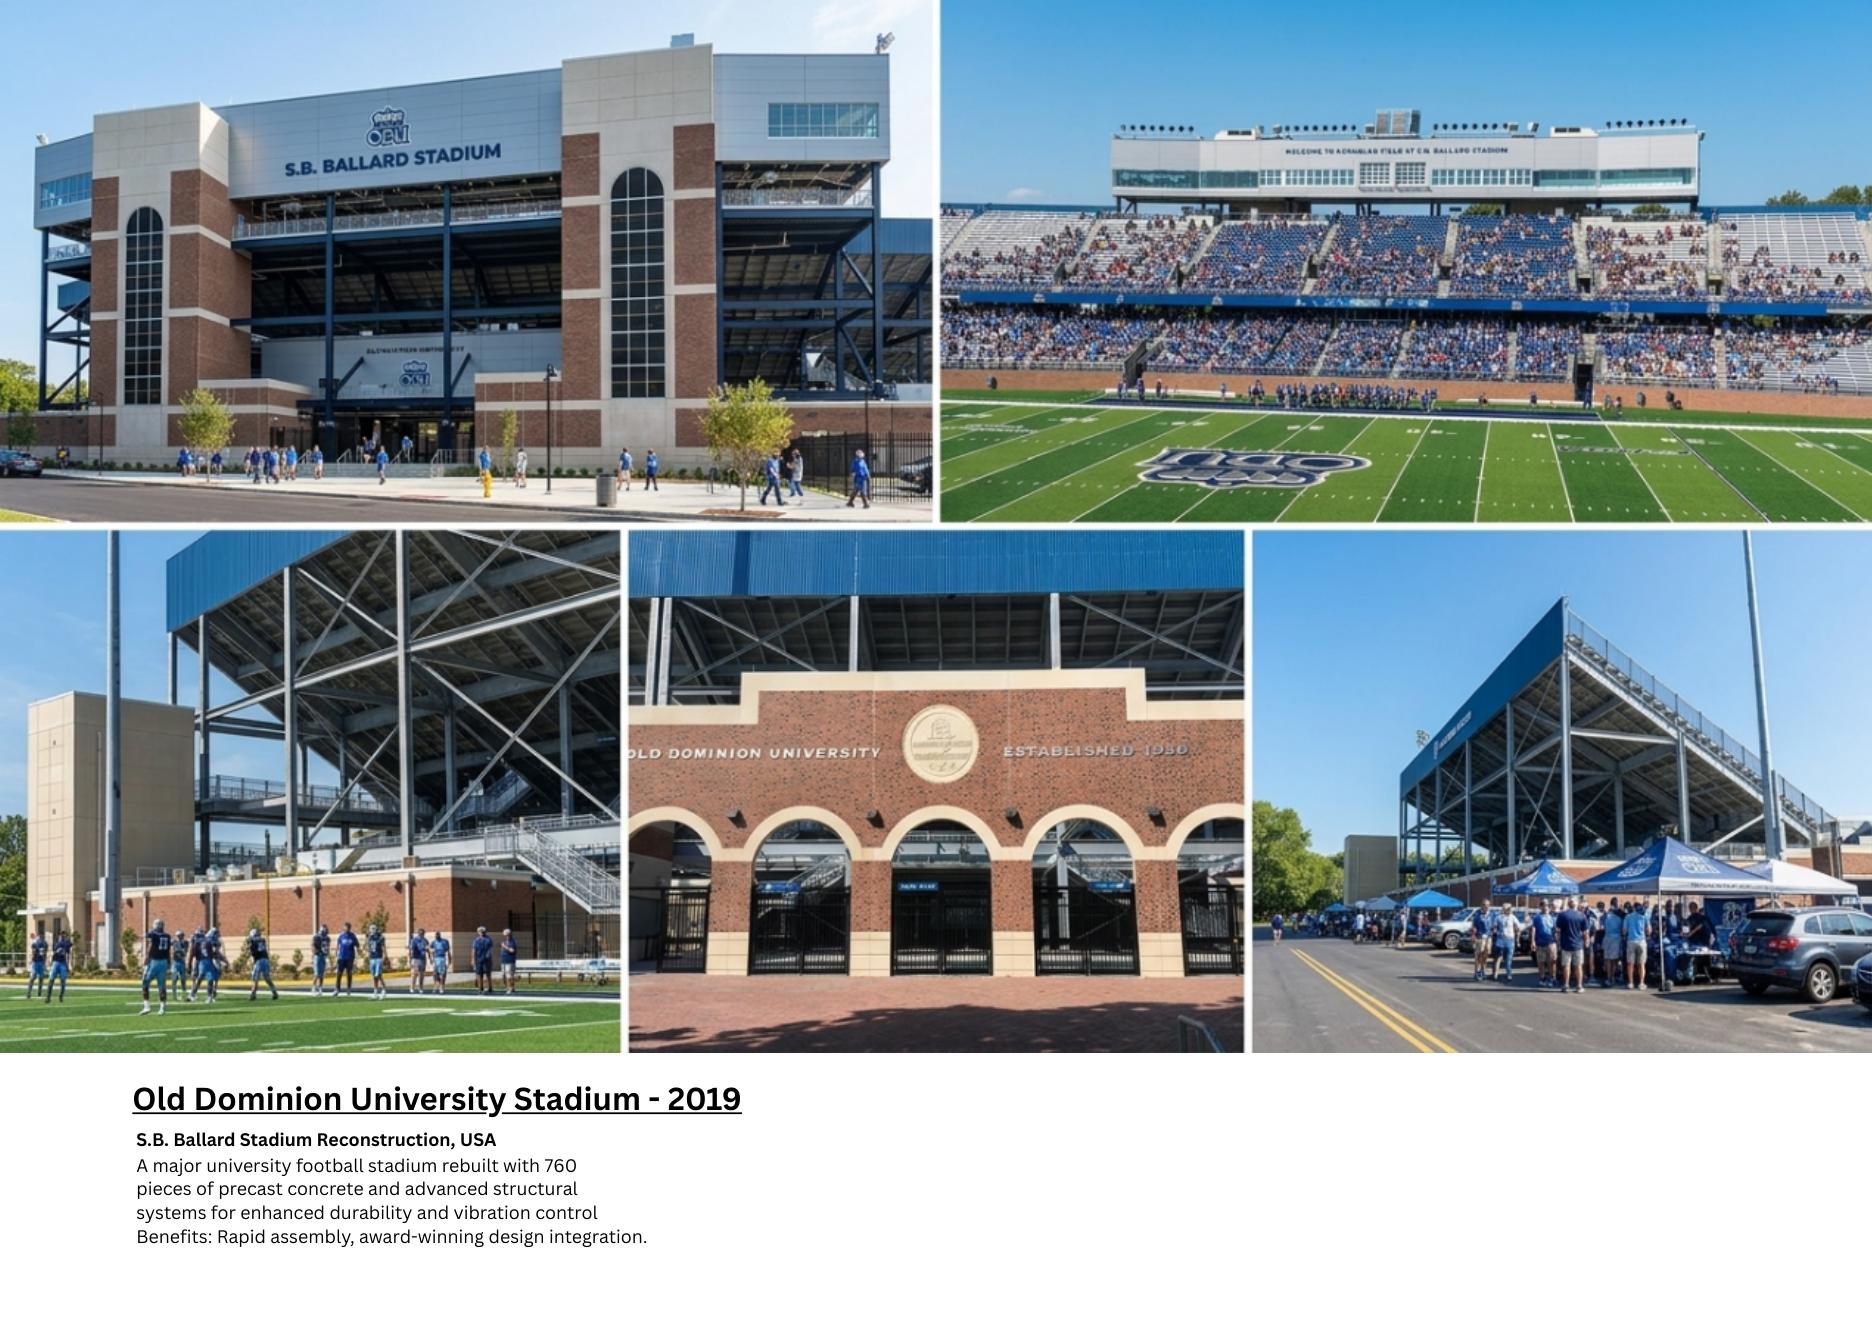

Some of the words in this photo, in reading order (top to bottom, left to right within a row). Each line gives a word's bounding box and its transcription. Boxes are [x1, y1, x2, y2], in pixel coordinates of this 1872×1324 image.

[285, 160, 317, 176] S.B.
[323, 153, 409, 174] BALLARD
[414, 143, 502, 165] STADIUM
[668, 748, 761, 759] DOMINION
[770, 748, 881, 759] UNIVERSITY
